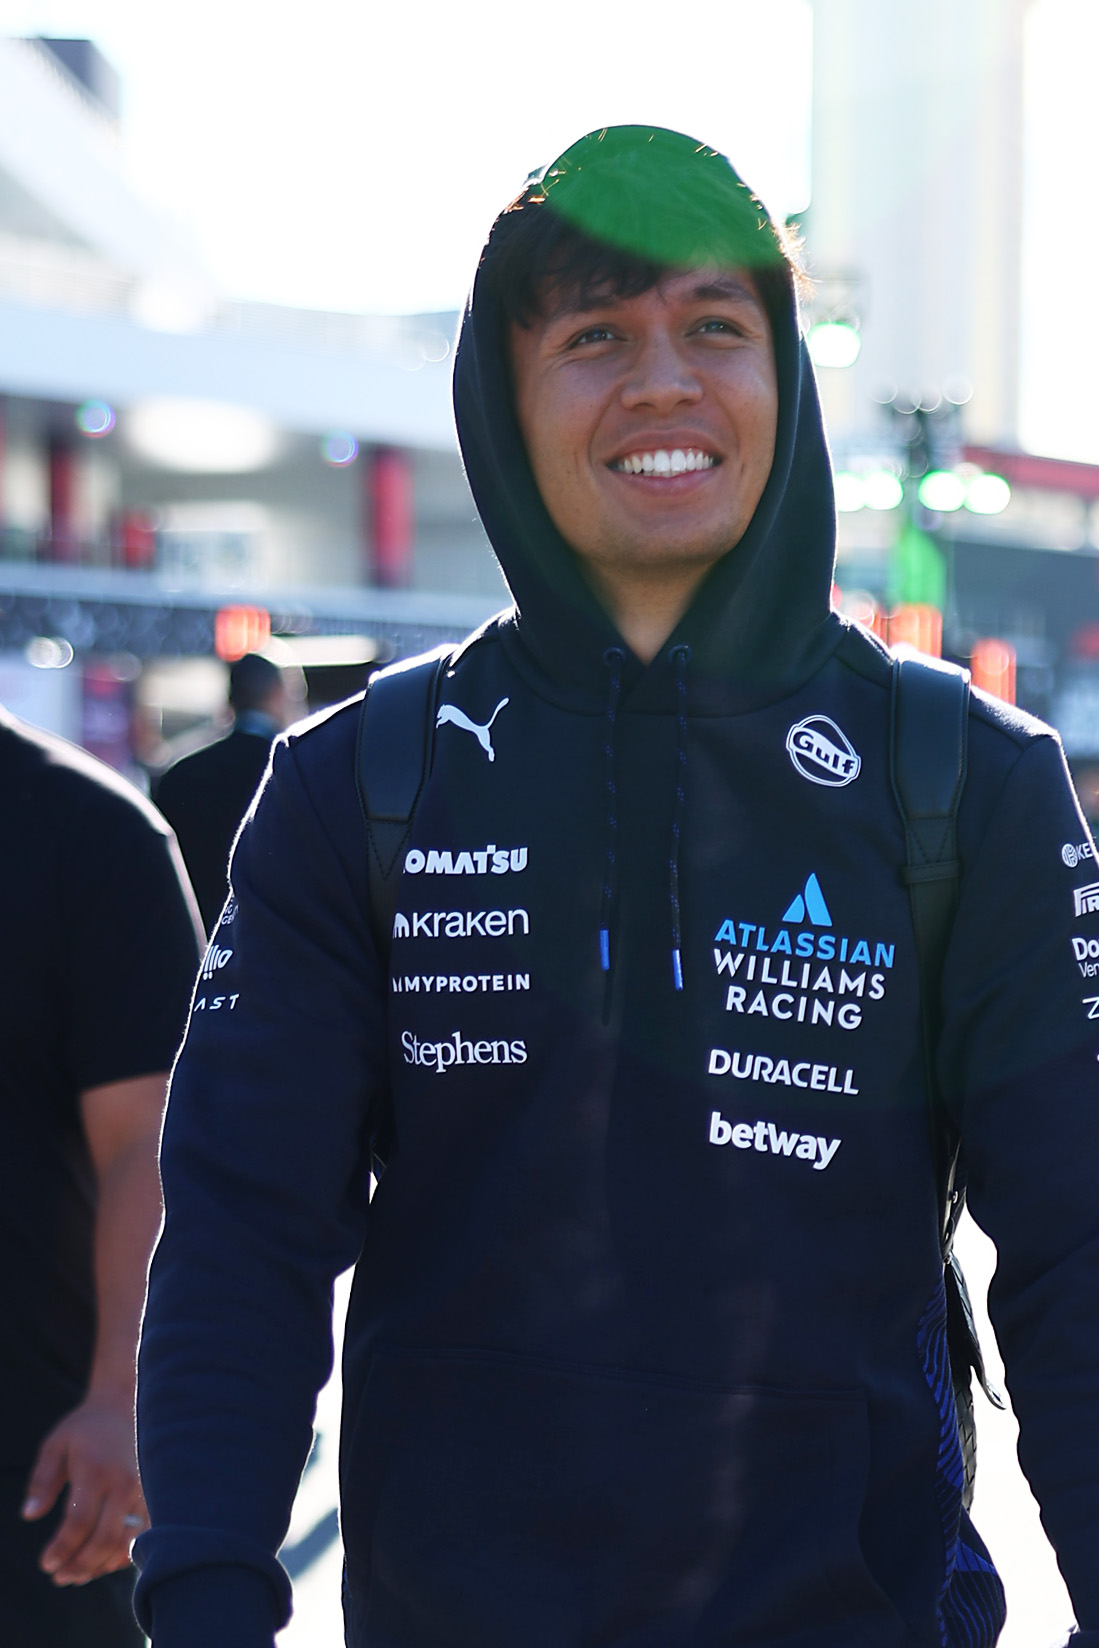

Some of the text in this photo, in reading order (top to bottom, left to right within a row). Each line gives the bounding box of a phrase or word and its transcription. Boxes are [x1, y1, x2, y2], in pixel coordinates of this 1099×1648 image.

[792, 730, 856, 775] Gulf
[403, 844, 528, 875] OMATSU
[714, 919, 896, 969] ATLASSIAN
[404, 973, 531, 993] MYPROTEIN
[713, 948, 887, 1001] WILLIAMS
[194, 993, 240, 1013] AST
[726, 985, 863, 1031] RACING
[401, 1030, 528, 1074] Stephens
[708, 1048, 860, 1096] DURACELL
[709, 1110, 842, 1171] betway
